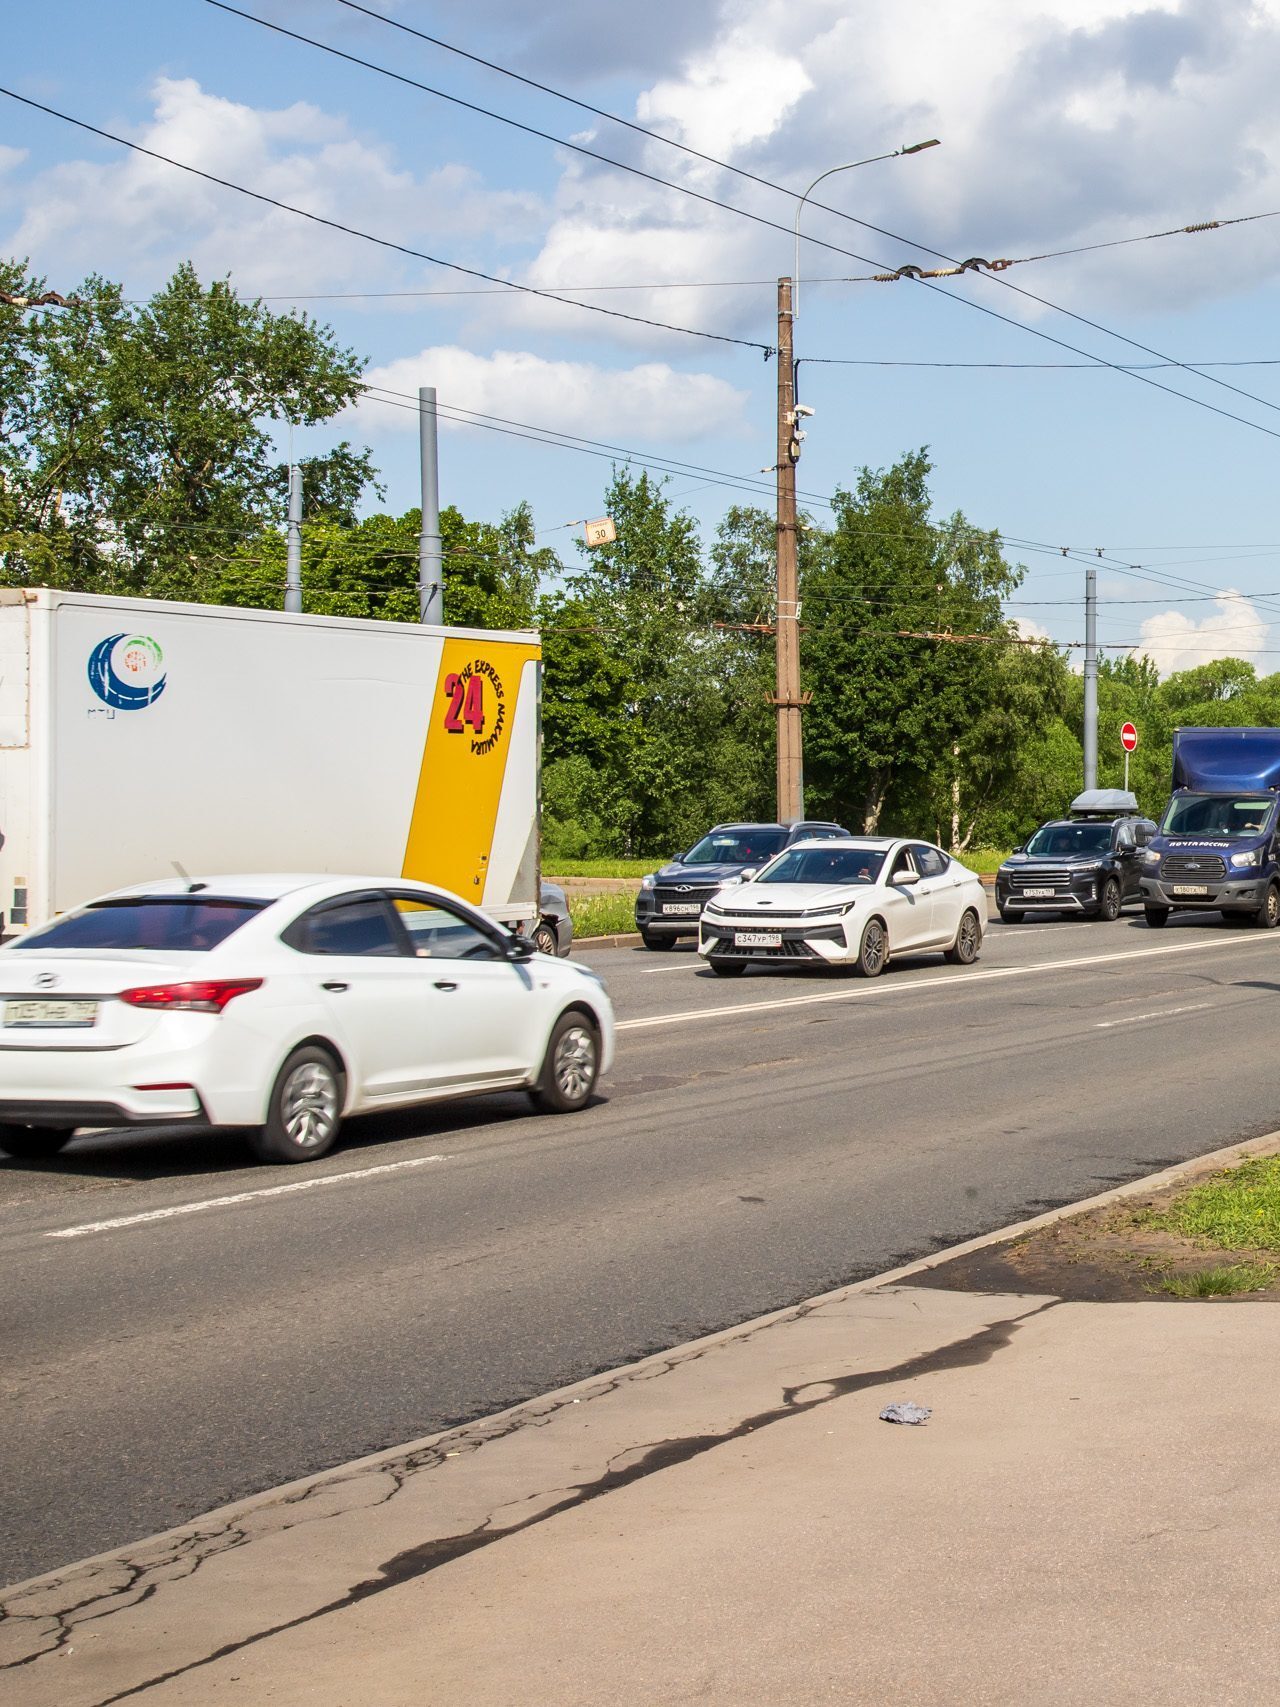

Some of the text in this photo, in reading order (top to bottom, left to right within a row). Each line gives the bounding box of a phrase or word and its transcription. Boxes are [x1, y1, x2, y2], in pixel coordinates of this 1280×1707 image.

[444, 673, 485, 734] 24
[457, 662, 473, 685] THE
[475, 660, 504, 698] EXPRESS
